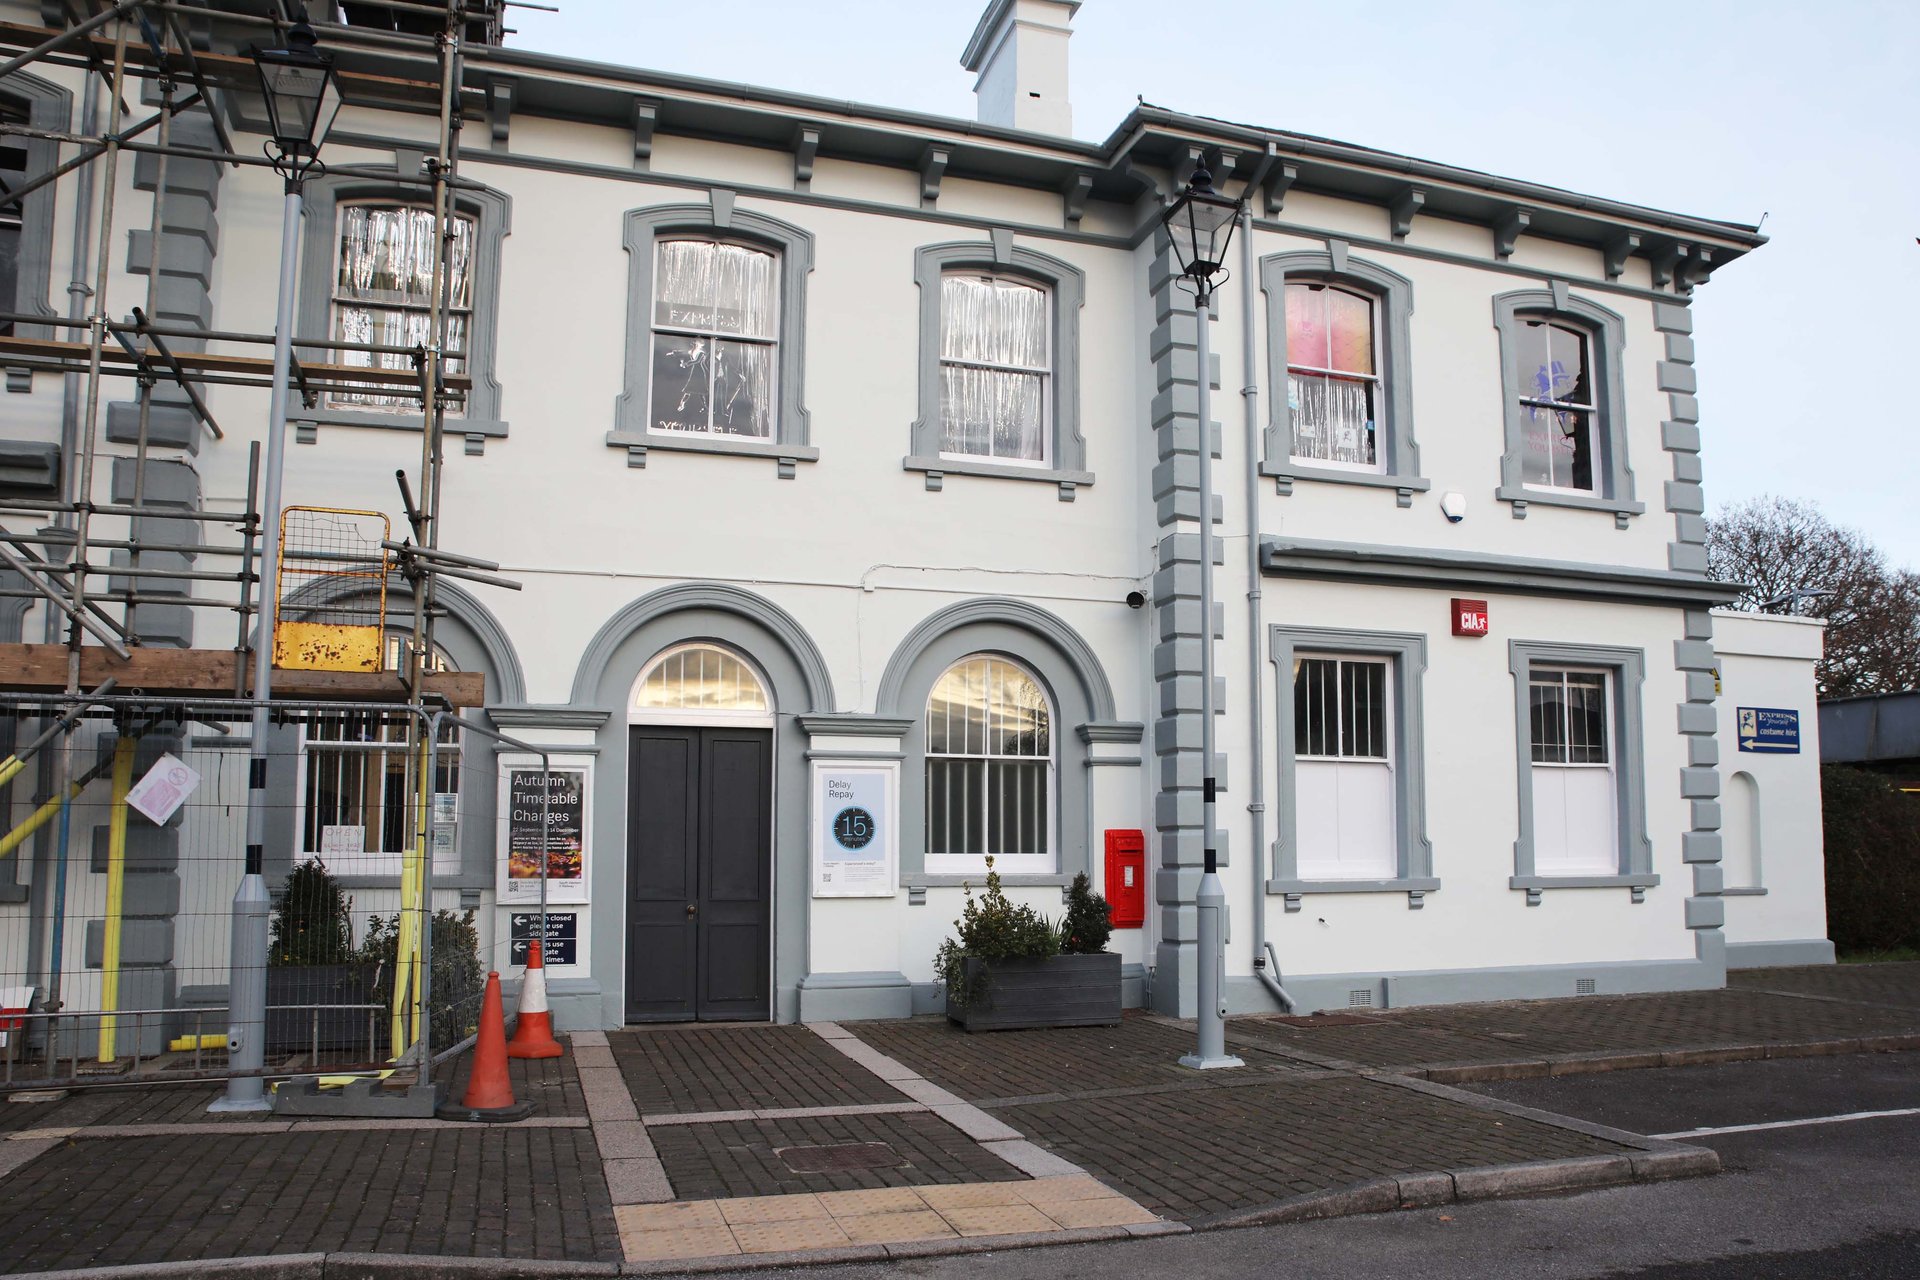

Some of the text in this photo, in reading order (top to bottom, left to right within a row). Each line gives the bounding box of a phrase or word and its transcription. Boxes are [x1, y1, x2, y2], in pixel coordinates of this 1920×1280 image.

[1461, 612, 1478, 629] CIA
[1758, 711, 1797, 723] EXPRESS
[1760, 728, 1784, 736] costume
[514, 774, 565, 787] Autumn
[828, 780, 852, 790] Delay
[513, 791, 578, 805] Timetable
[828, 789, 854, 800] Repay
[326, 828, 362, 836] OPEN
[842, 816, 867, 836] 15
